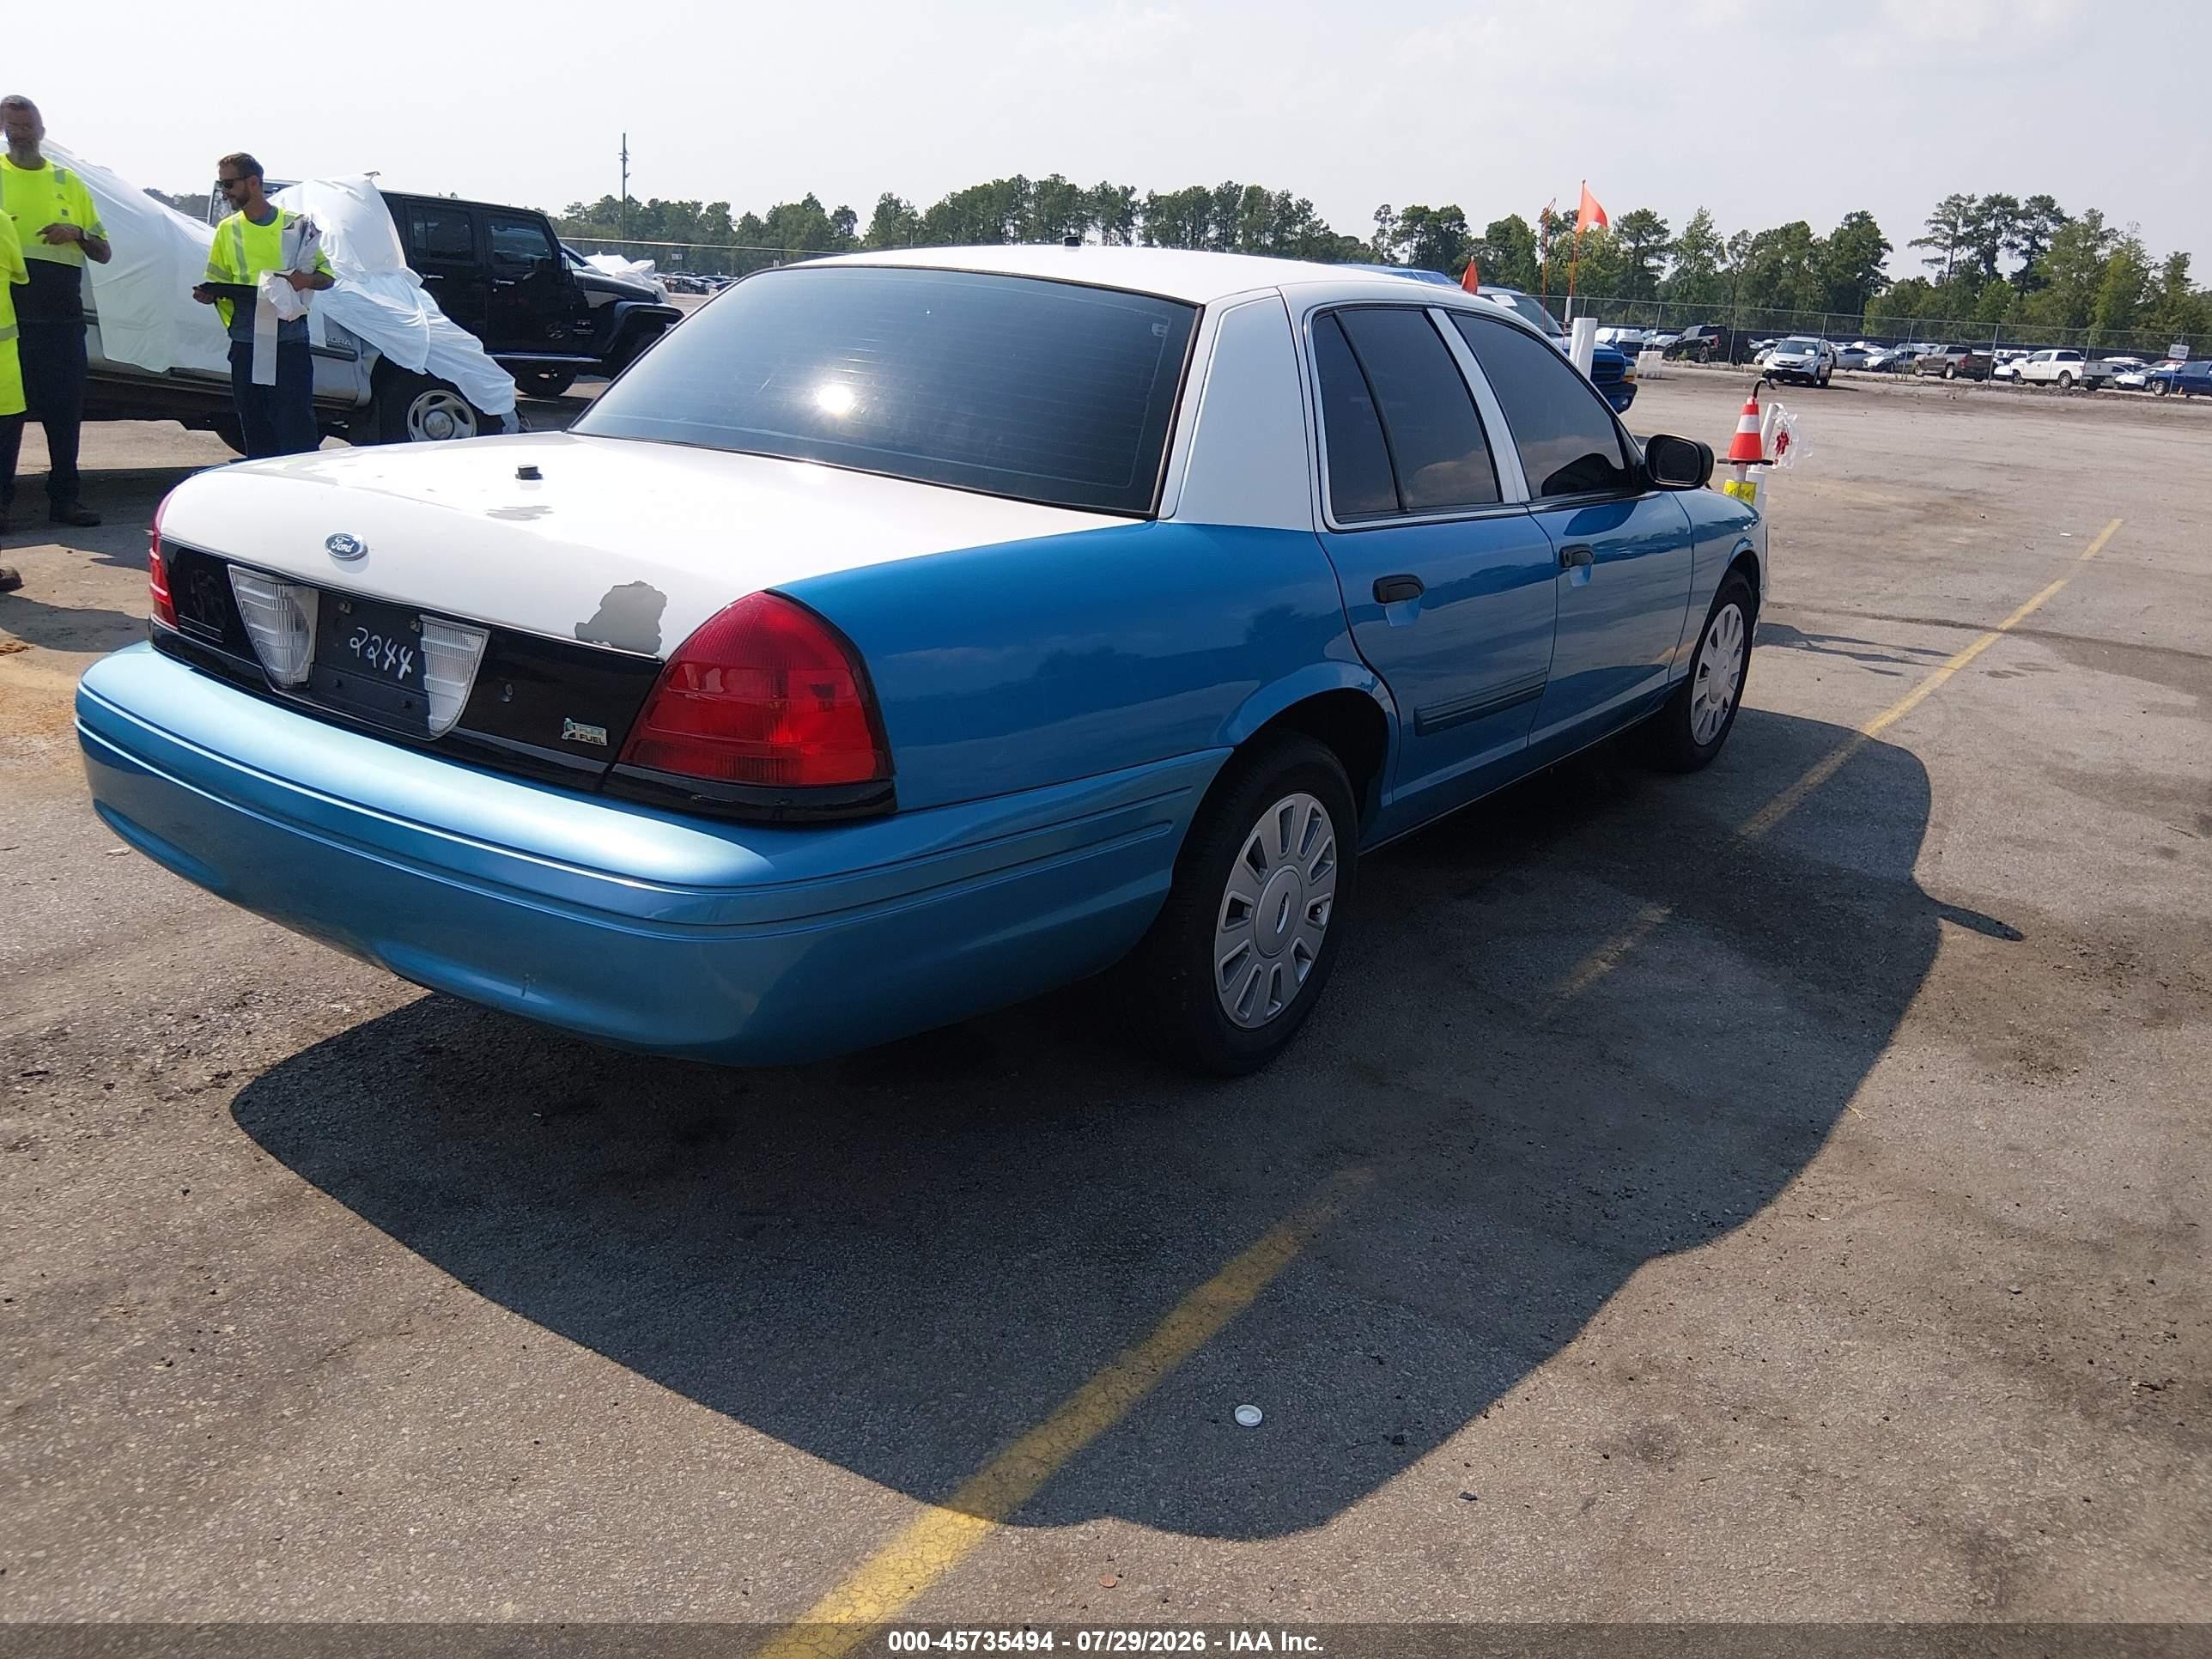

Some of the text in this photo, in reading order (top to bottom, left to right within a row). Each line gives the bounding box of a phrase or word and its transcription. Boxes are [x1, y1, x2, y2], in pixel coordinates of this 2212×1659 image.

[331, 536, 355, 553] Ford
[349, 627, 414, 680] 2244
[579, 733, 605, 745] FUEL
